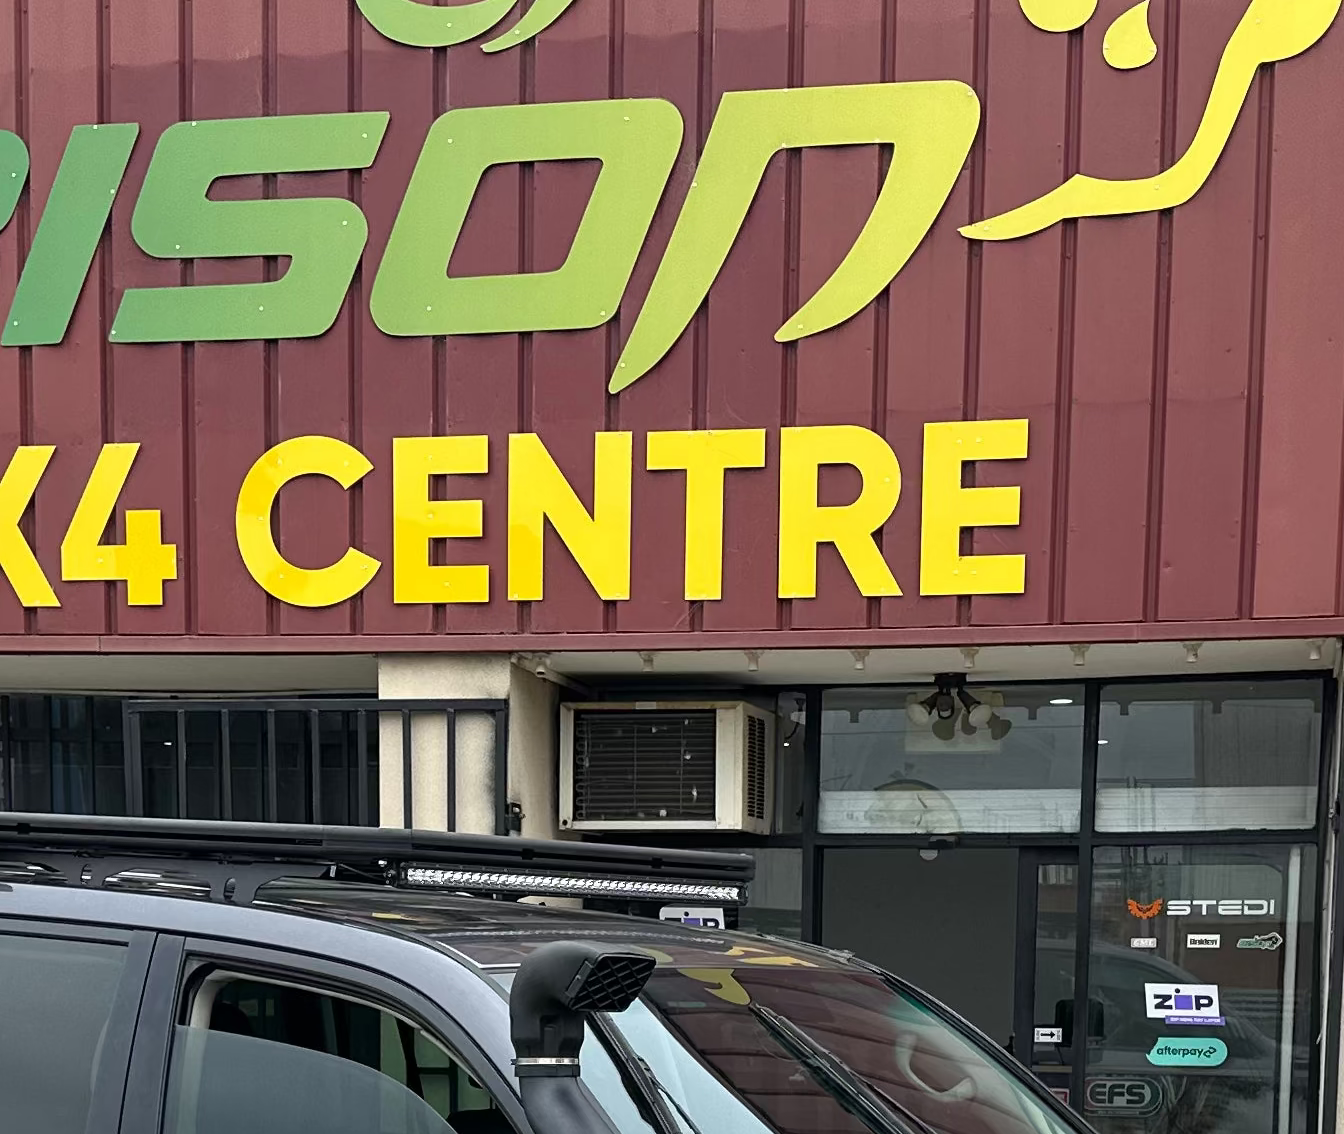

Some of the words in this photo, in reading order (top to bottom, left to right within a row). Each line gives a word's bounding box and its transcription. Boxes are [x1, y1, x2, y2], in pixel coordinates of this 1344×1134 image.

[235, 417, 1030, 608] CENTRE
[1166, 899, 1275, 916] STEDI
[1156, 1046, 1205, 1059] afterpay
[1089, 1083, 1146, 1105] EFS
